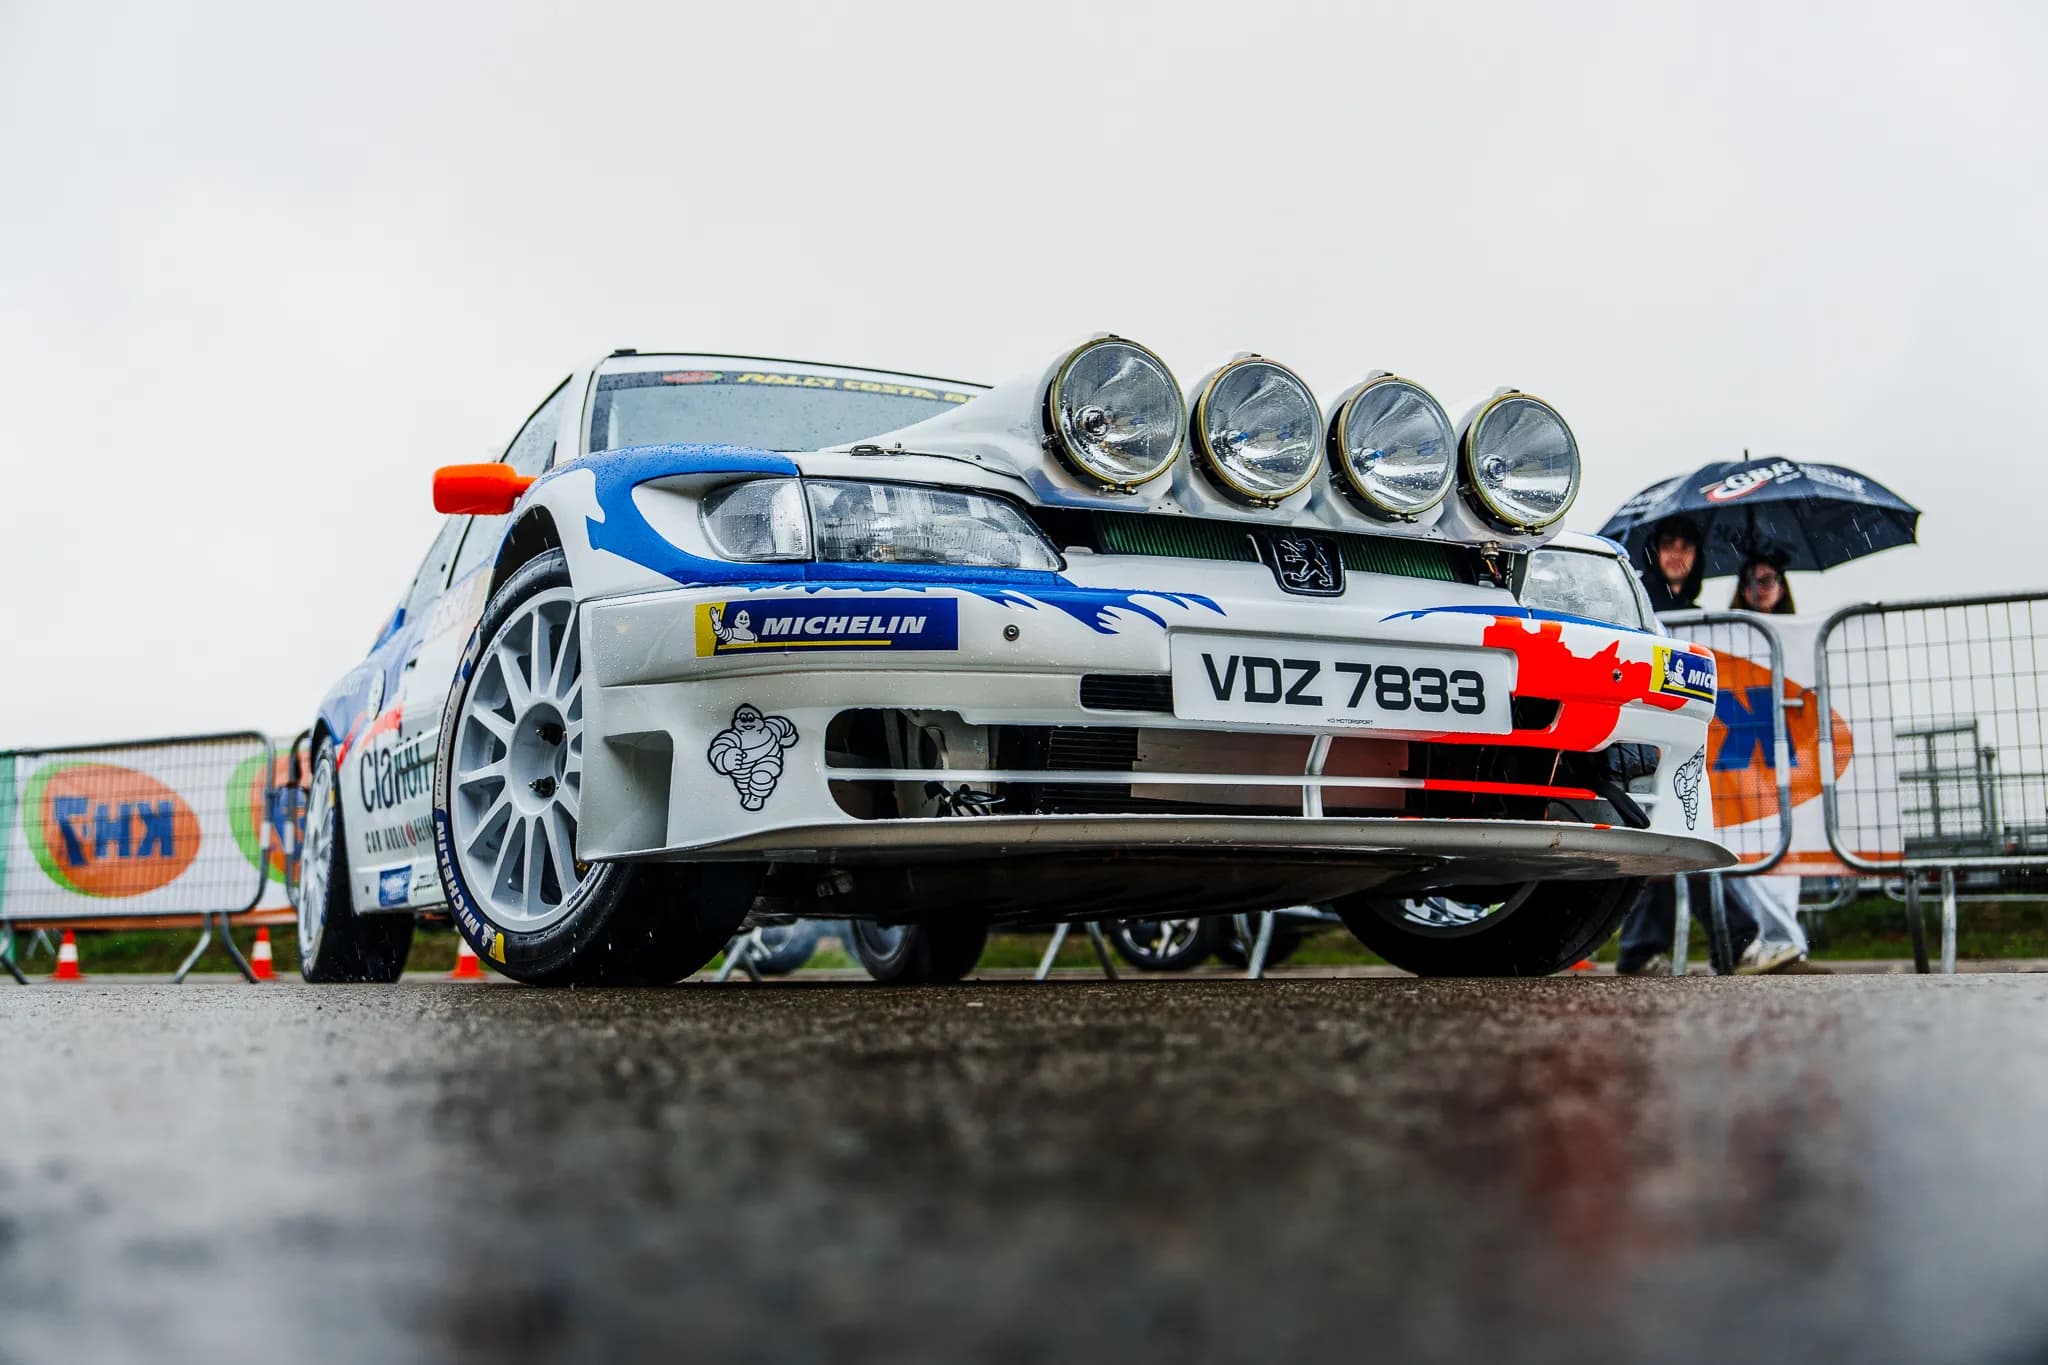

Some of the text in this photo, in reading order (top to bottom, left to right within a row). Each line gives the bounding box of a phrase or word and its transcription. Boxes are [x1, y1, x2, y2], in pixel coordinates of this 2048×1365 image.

[737, 373, 837, 388] RALLY
[843, 379, 939, 400] COSTA
[761, 616, 927, 637] MICHELIN
[1201, 653, 1486, 714] VDZ 7833
[435, 821, 481, 938] MICHELIN
